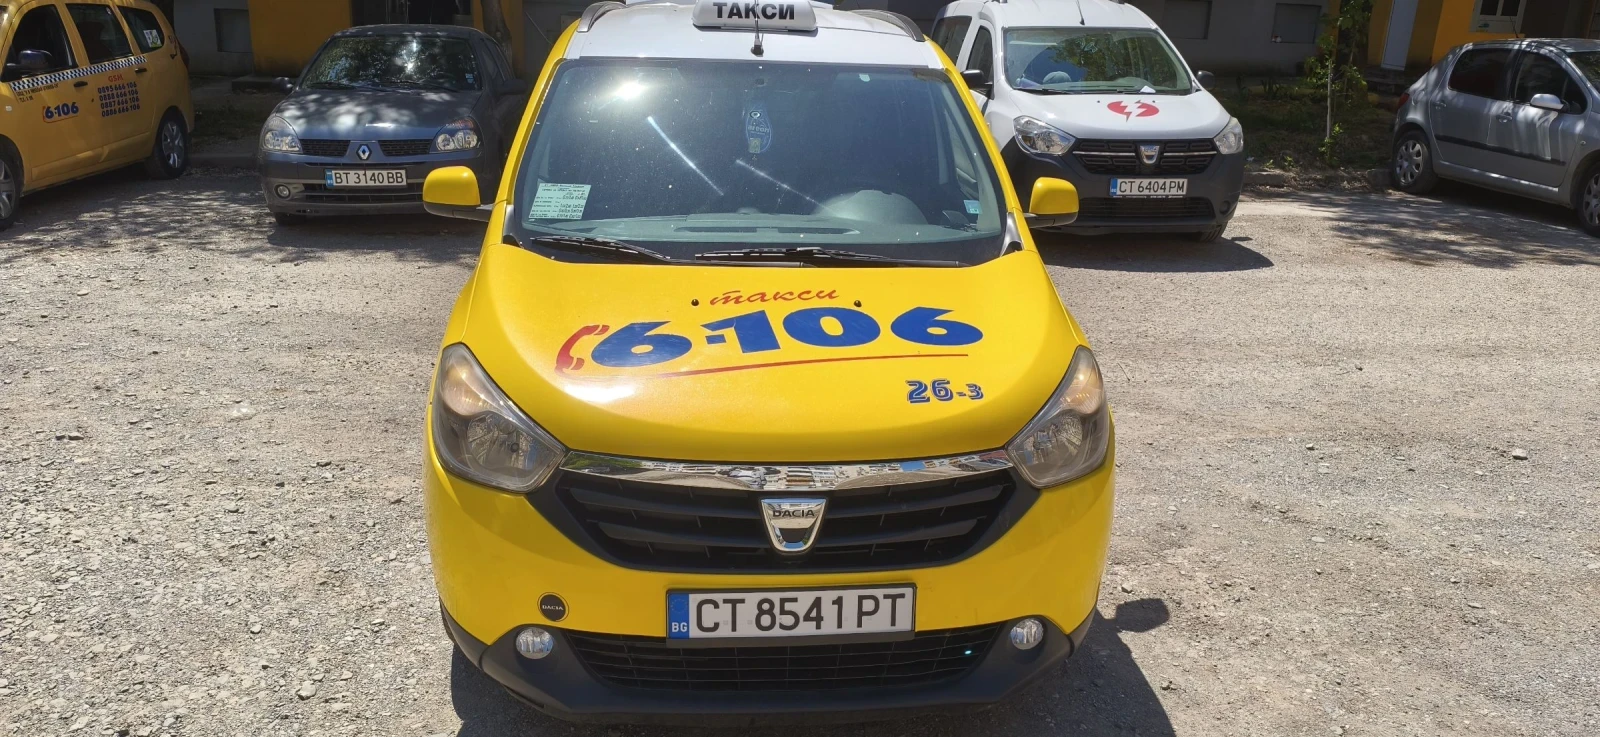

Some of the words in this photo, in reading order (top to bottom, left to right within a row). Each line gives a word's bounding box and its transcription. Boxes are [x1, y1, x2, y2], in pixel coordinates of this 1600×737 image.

[713, 2, 795, 20] ТАКСИ
[108, 74, 124, 82] GSM
[126, 81, 137, 89] 106
[130, 103, 140, 111] 106
[334, 172, 351, 184] BT
[353, 170, 385, 184] 3140
[387, 172, 404, 184] BB
[1119, 181, 1136, 193] CT
[1138, 181, 1167, 193] 6404
[1169, 181, 1185, 193] PM
[710, 290, 839, 305] такси
[591, 307, 983, 367] 6-106
[905, 378, 984, 403] 26-3
[773, 509, 814, 518] DACIA
[696, 598, 746, 632] CT
[755, 596, 844, 631] 8541
[857, 593, 906, 628] PT
[671, 621, 688, 633] BG
